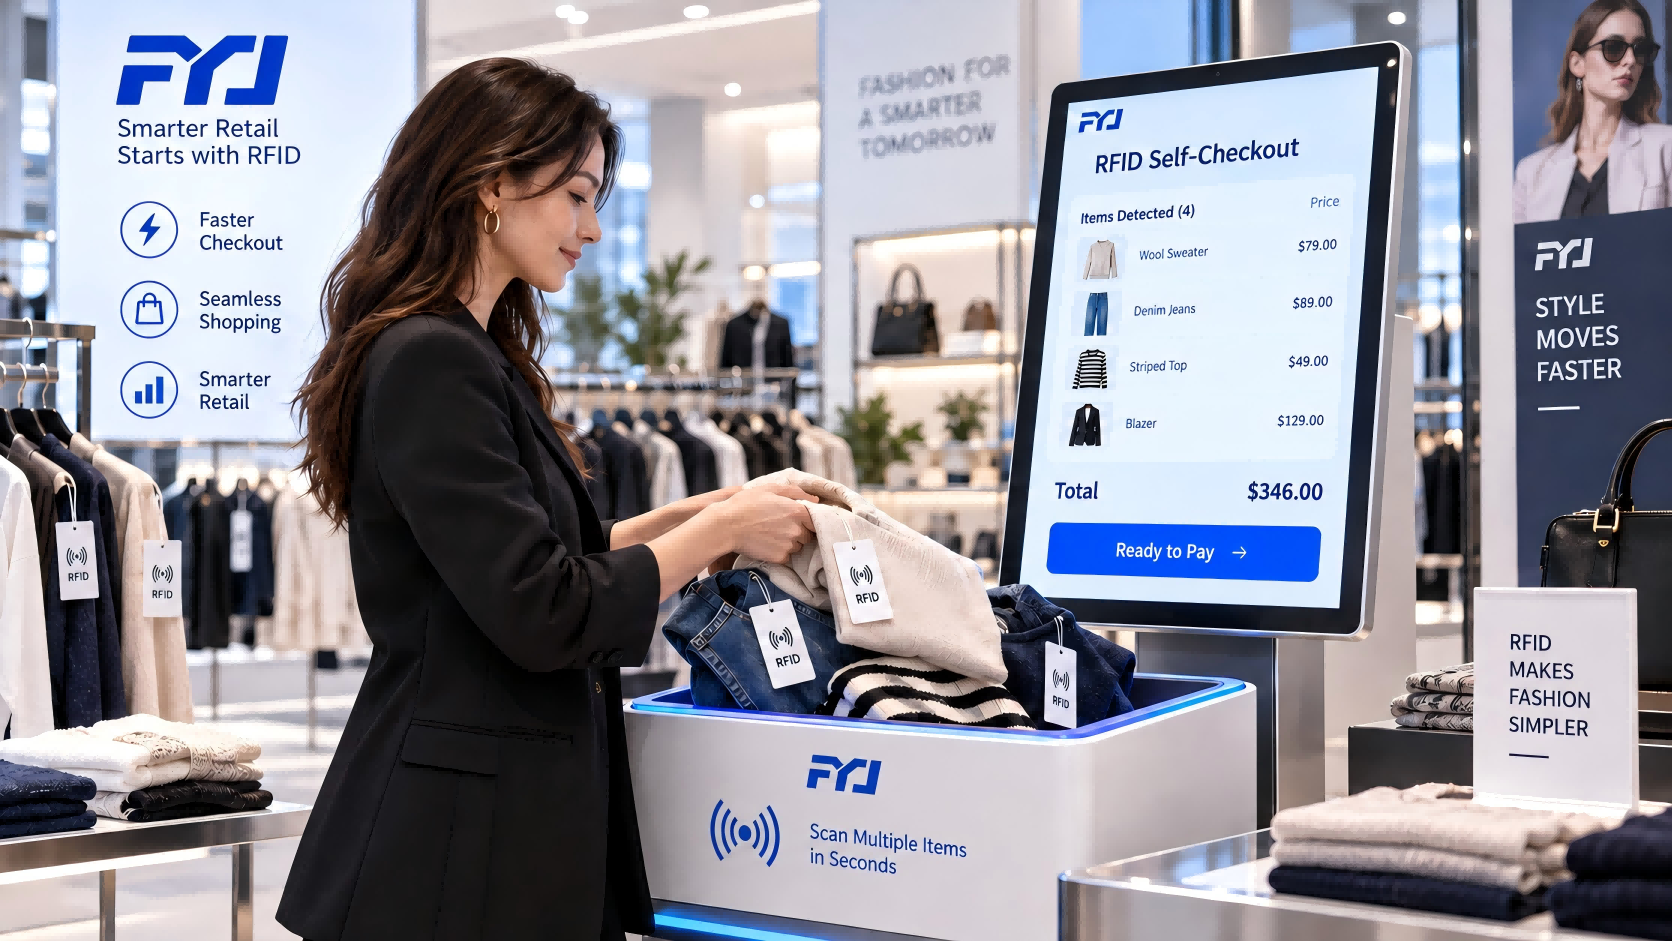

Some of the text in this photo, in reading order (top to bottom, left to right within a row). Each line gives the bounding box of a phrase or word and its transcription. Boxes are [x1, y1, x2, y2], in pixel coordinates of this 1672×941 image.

[116, 35, 288, 105] FYJ
[858, 54, 1011, 98] FASHION FOR
[858, 90, 981, 129] A SMARTER
[118, 118, 278, 137] Smarter Retail
[858, 122, 996, 159] TOMORROW
[118, 145, 300, 164] Starts with RFID
[1096, 138, 1299, 174] RFID Self-Checkout
[1311, 196, 1339, 208] Price
[201, 212, 254, 227] Faster
[1081, 204, 1195, 224] Items Detected (4)
[200, 234, 283, 250] Checkout
[1298, 239, 1337, 252] $79.00
[1140, 248, 1208, 260] Wool Sweater
[1535, 238, 1593, 271] FYJ
[200, 290, 281, 306] Seamless
[1293, 296, 1332, 309] $89.00
[1536, 293, 1604, 317] STYLE
[1134, 305, 1195, 316] Denim Jeans
[200, 313, 281, 333] Shopping
[1537, 325, 1619, 349] MOVES
[1130, 360, 1187, 374] Striped Top
[1289, 355, 1328, 368] $49.00
[1538, 358, 1621, 381] FASTER
[200, 371, 271, 387] Smarter
[200, 393, 249, 409] Retail
[1126, 418, 1157, 428] Blazer
[1278, 415, 1324, 427] $129.00
[1055, 481, 1098, 499] Total
[1248, 481, 1323, 502] $346.00
[1116, 542, 1214, 563] Ready to Pay
[68, 572, 89, 581] RFID
[152, 590, 172, 599] RFID
[856, 592, 879, 604] RFID
[1511, 634, 1551, 651] RFID
[776, 654, 800, 667] RFID
[1510, 661, 1573, 679] MAKES
[1053, 695, 1069, 708] RFID
[1510, 688, 1590, 708] FASHION
[1509, 716, 1588, 737] SIMPLER
[806, 755, 882, 795] FYJ
[810, 823, 966, 857] Scan Multiple Items
[811, 848, 897, 875] in Seconds
